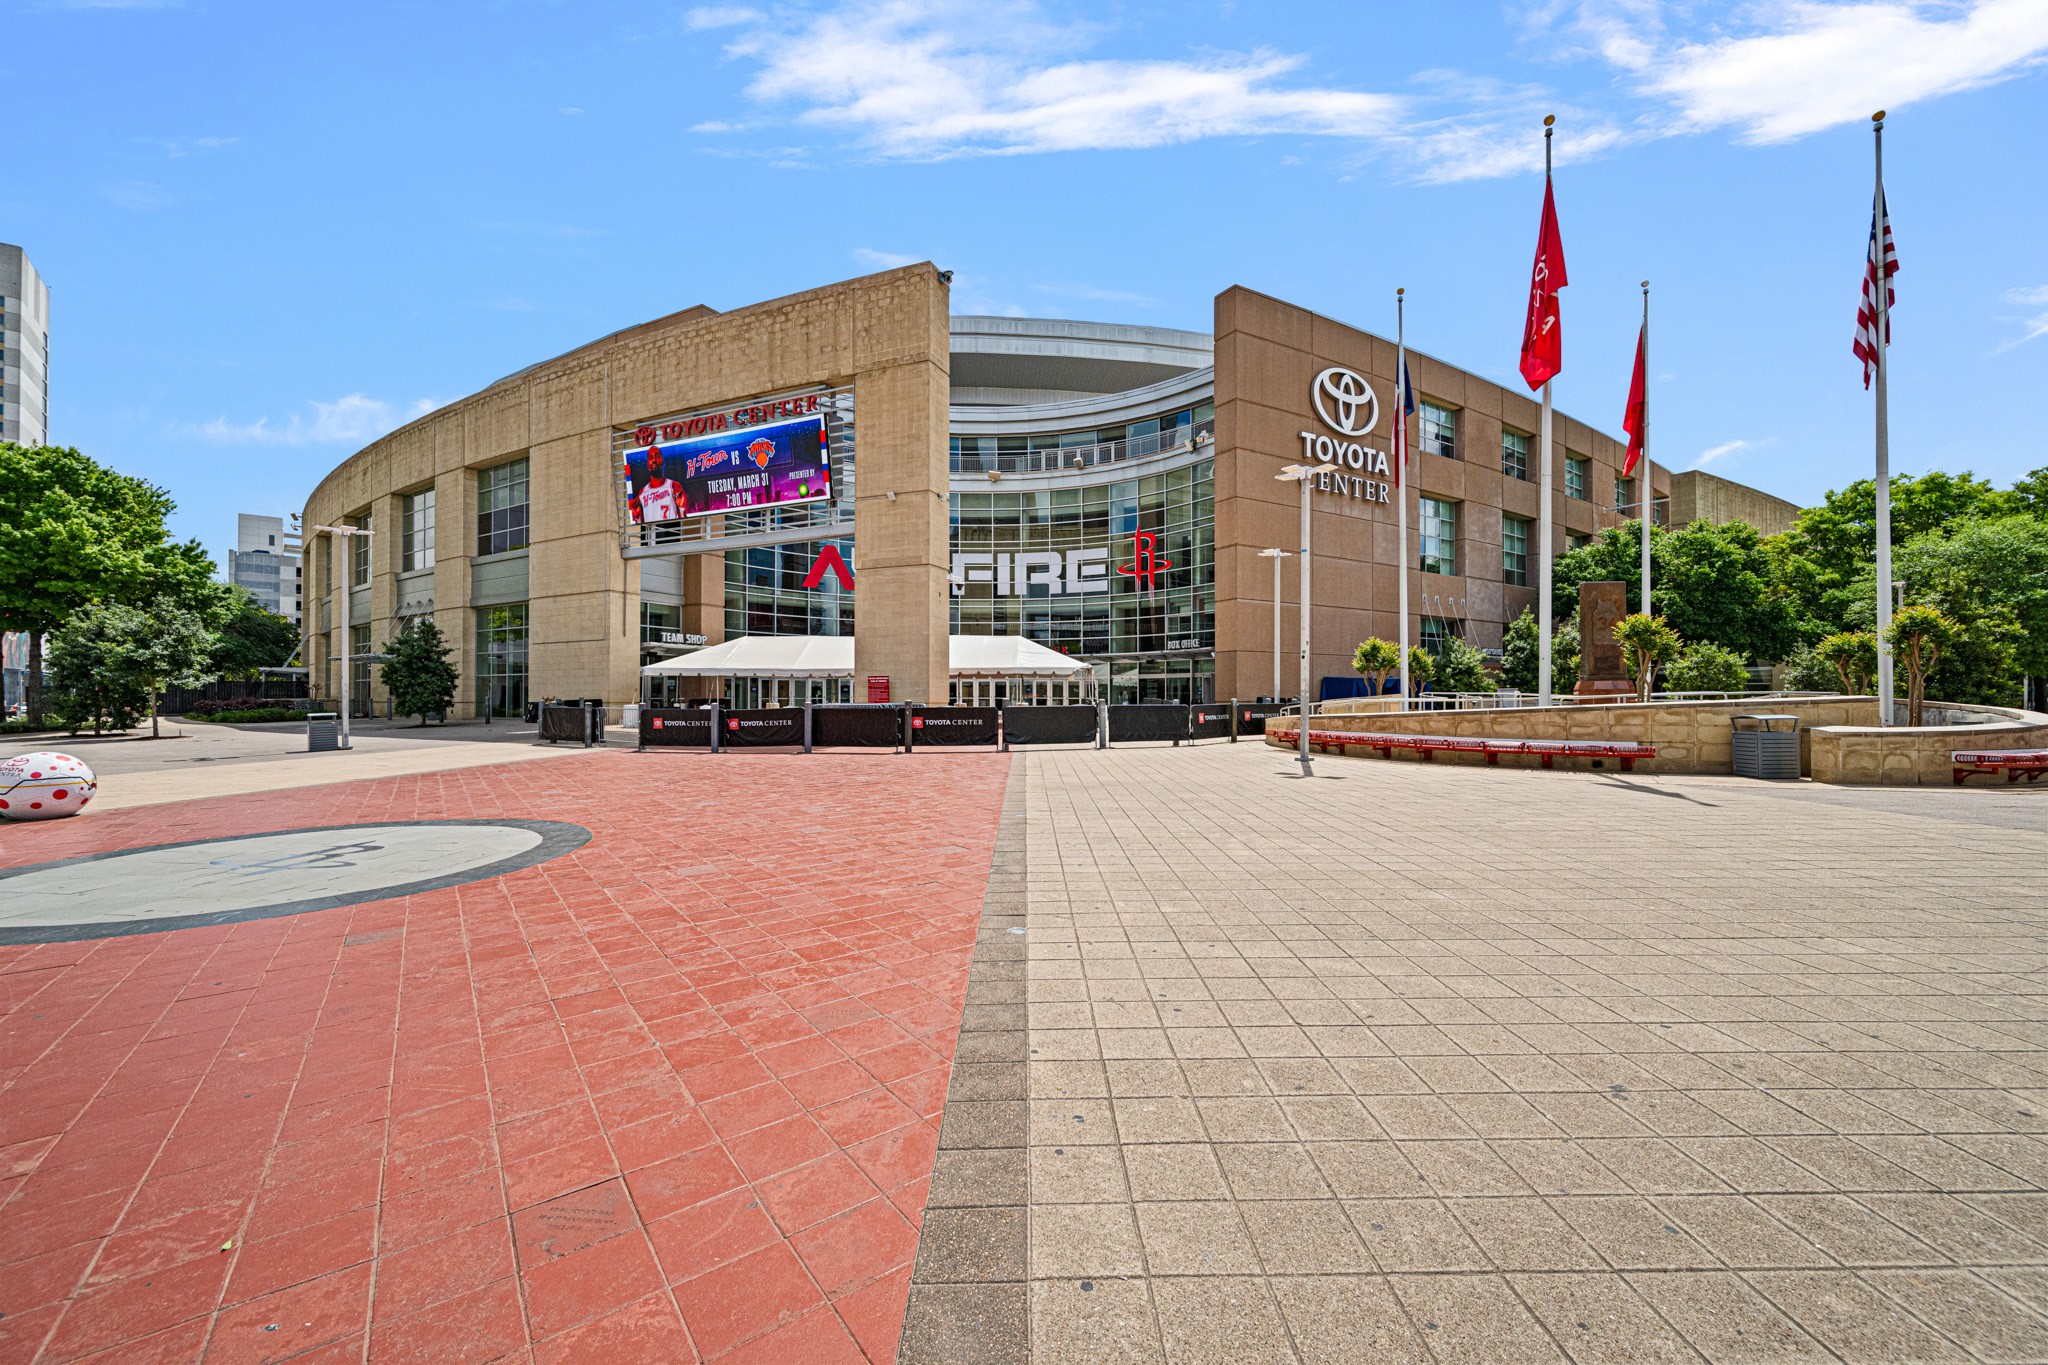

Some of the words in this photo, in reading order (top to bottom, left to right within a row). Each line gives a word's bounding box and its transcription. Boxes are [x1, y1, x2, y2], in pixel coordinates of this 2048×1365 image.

[660, 413, 728, 440] TOYOTA
[733, 395, 818, 425] CENTER
[1299, 431, 1390, 476] TOYOTA
[686, 449, 729, 479] H-Town
[731, 450, 740, 466] VS
[707, 477, 737, 494] TUESDAY,
[738, 474, 760, 490] MARCH
[761, 472, 769, 486] 31
[789, 470, 809, 480] PRESENTED
[1309, 470, 1391, 504] ENTER
[726, 493, 741, 507] 7:00
[742, 491, 752, 505] PM
[660, 505, 669, 520] 7
[952, 547, 1109, 596] FIRE
[661, 631, 685, 643] TEAM
[685, 633, 708, 645] SHOP
[1167, 640, 1180, 649] BOX
[1181, 638, 1201, 648] OFFICE
[764, 719, 793, 727] CENTER
